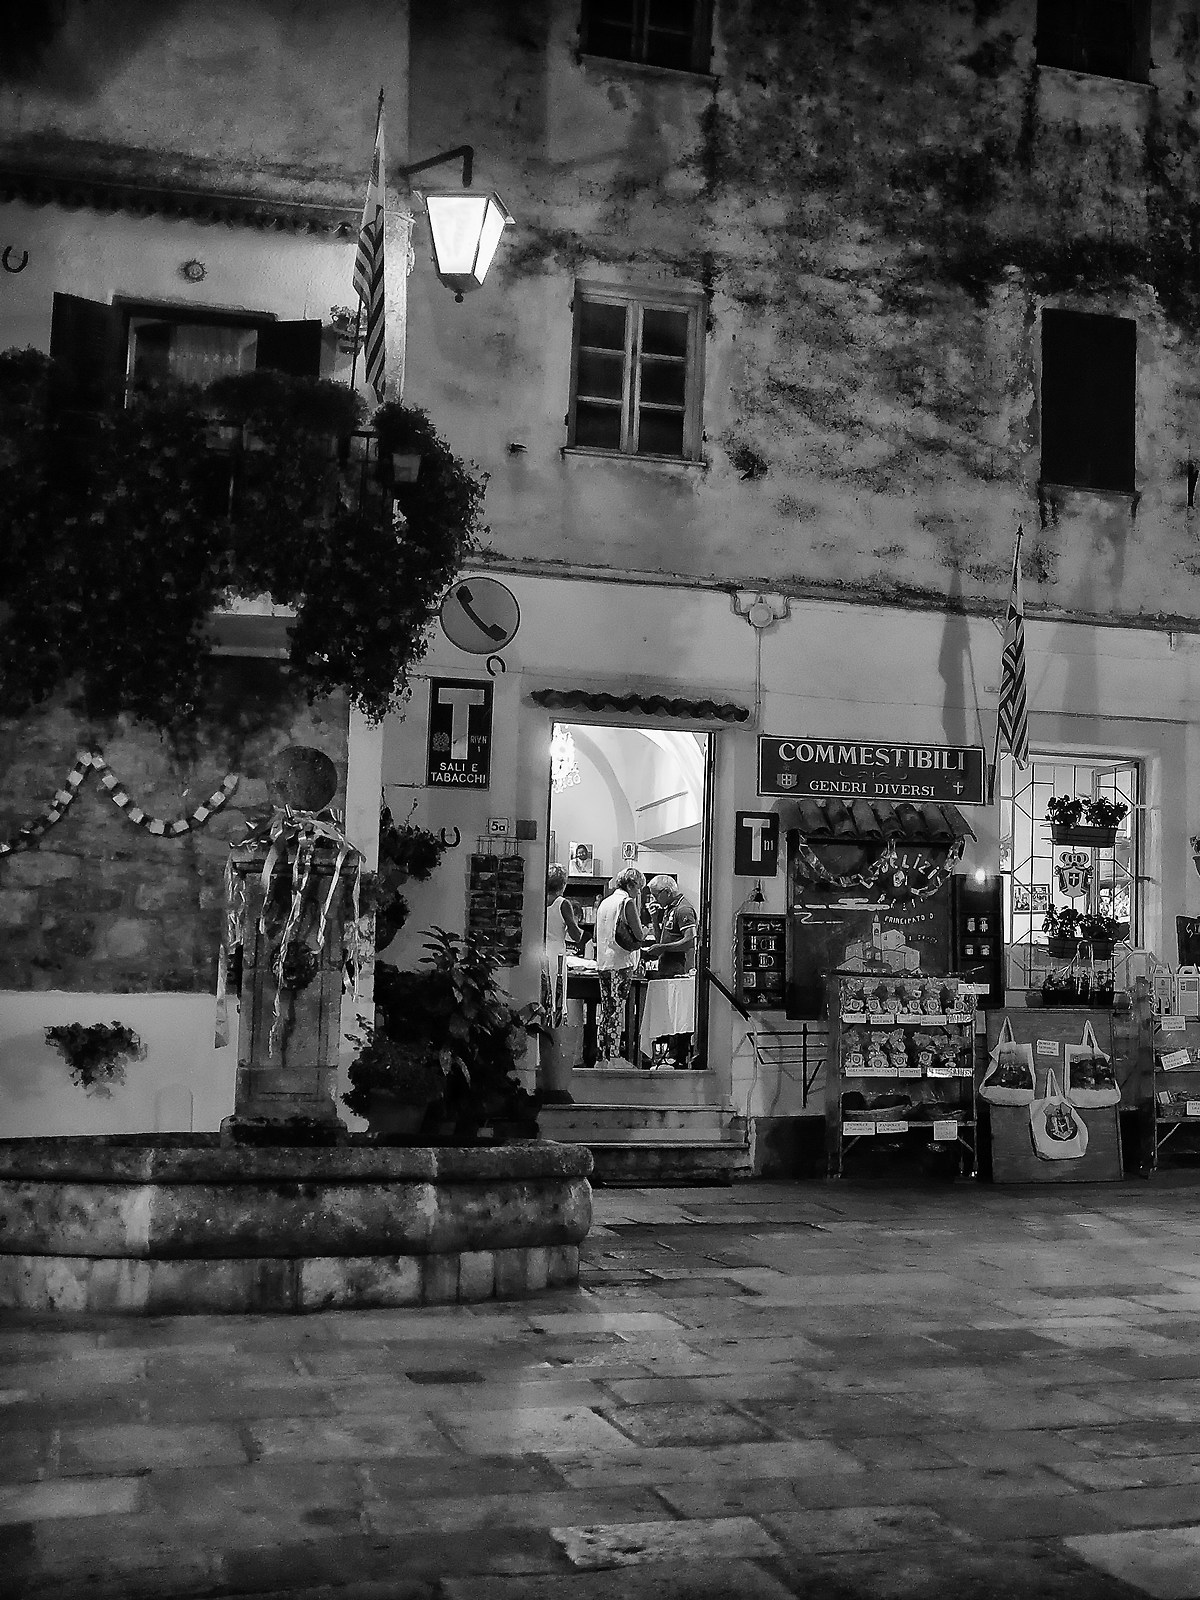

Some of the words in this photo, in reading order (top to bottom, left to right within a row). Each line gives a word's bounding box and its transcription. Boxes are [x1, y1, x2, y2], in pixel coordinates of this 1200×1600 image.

[437, 687, 485, 760] T
[778, 742, 965, 771] COMMESTIBILI
[439, 762, 465, 772] SALI
[471, 763, 478, 772] E
[430, 772, 486, 784] TABACCHI
[809, 780, 867, 793] GENERI
[874, 783, 935, 797] DIVERSI
[491, 821, 506, 831] 5a
[742, 817, 770, 862] T
[884, 914, 926, 925] PRINCIPATO
